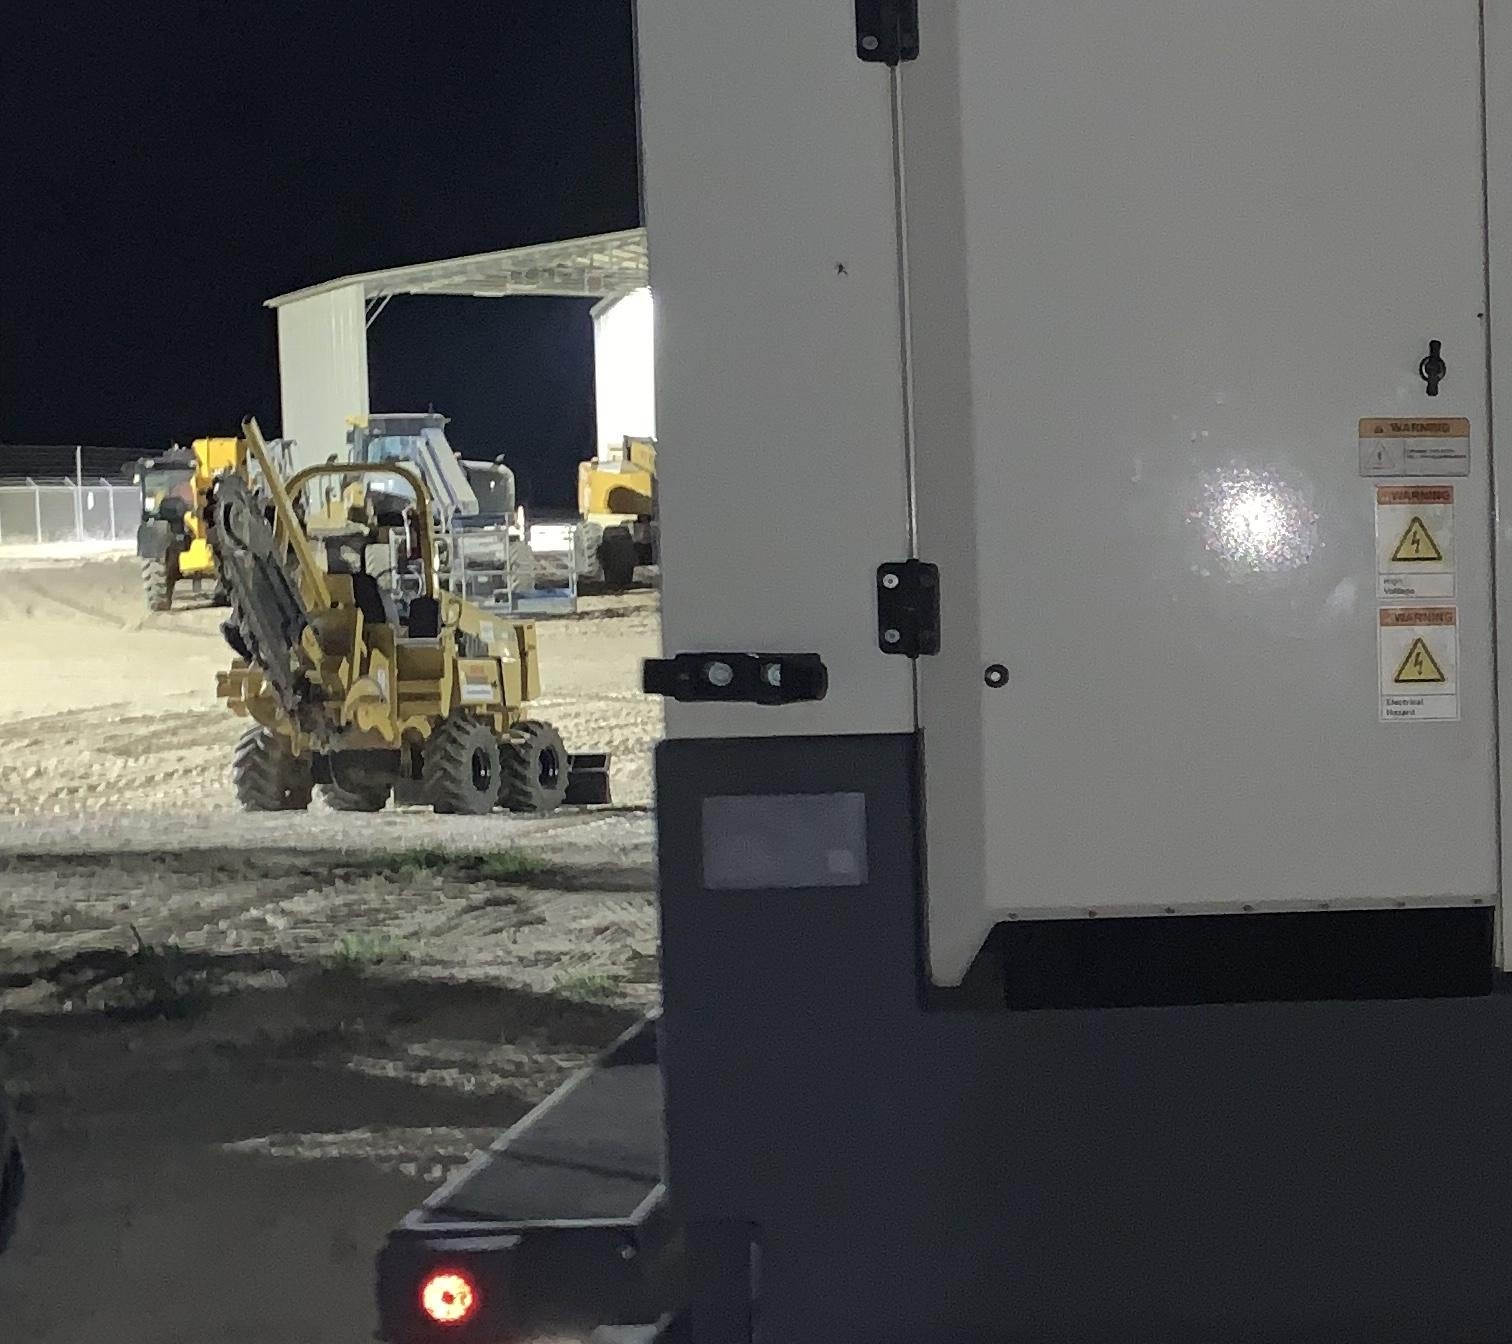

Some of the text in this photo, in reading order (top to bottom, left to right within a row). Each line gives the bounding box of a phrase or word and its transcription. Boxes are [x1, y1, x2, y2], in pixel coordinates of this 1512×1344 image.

[1390, 422, 1451, 434] WARNING
[1391, 489, 1451, 501] WARNING
[1394, 611, 1453, 623] WARNING
